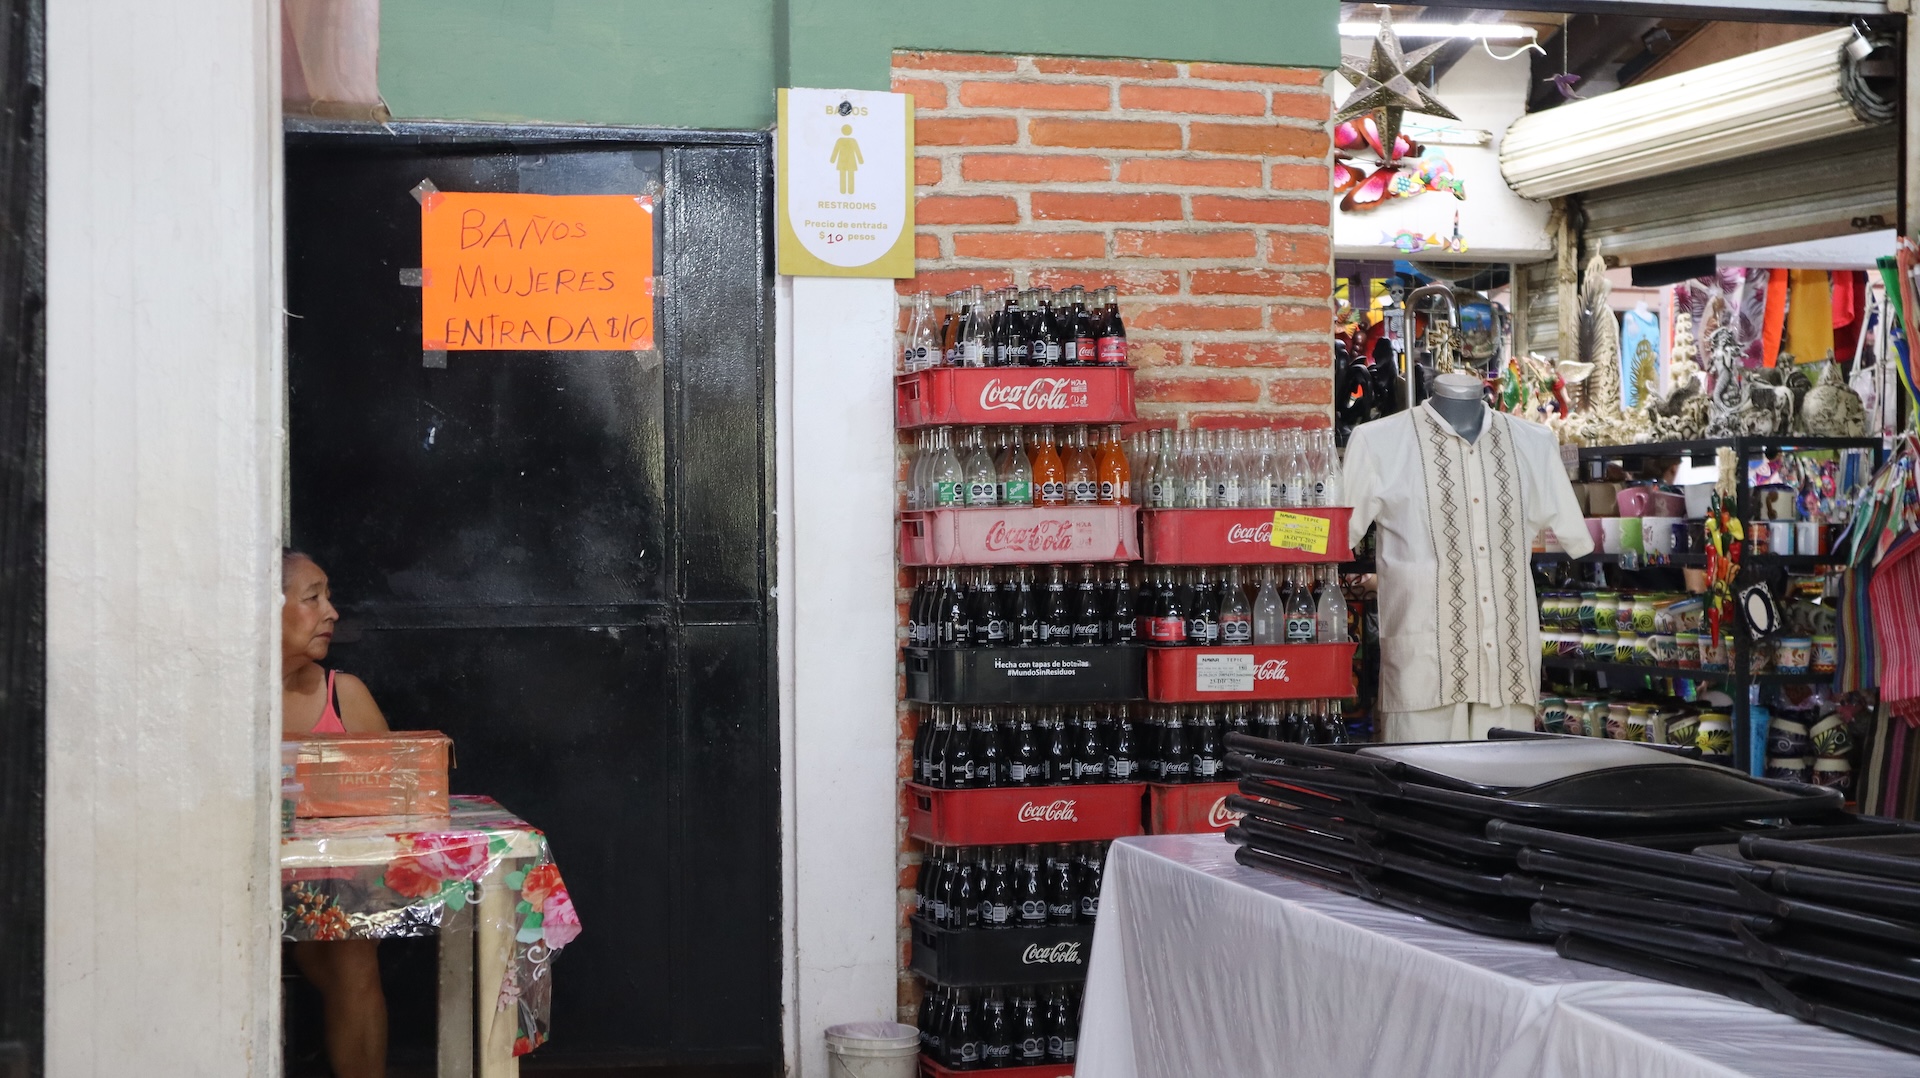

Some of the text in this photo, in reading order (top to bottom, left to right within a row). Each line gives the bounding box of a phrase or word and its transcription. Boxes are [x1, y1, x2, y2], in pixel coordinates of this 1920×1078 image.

[825, 105, 868, 116] BAOS
[817, 201, 876, 210] RESTROOMS
[460, 208, 588, 250] BAÑOS
[804, 219, 888, 229] Precio de entrada
[847, 233, 876, 242] pesos
[453, 264, 615, 303] MUJERES
[444, 313, 600, 348] ENTRADA
[979, 377, 1071, 411] Coca-Cola
[985, 520, 1073, 552] Coca-Cola
[1228, 522, 1272, 544] Coca-Co
[994, 658, 1017, 669] Hecha
[1031, 660, 1051, 670] tapas
[1052, 660, 1060, 668] de
[1007, 669, 1076, 677] #MundoSinResiduos
[1252, 659, 1288, 681] a-Cola
[1018, 800, 1077, 822] Coca-Cola
[1022, 942, 1081, 964] Coca-Cola
